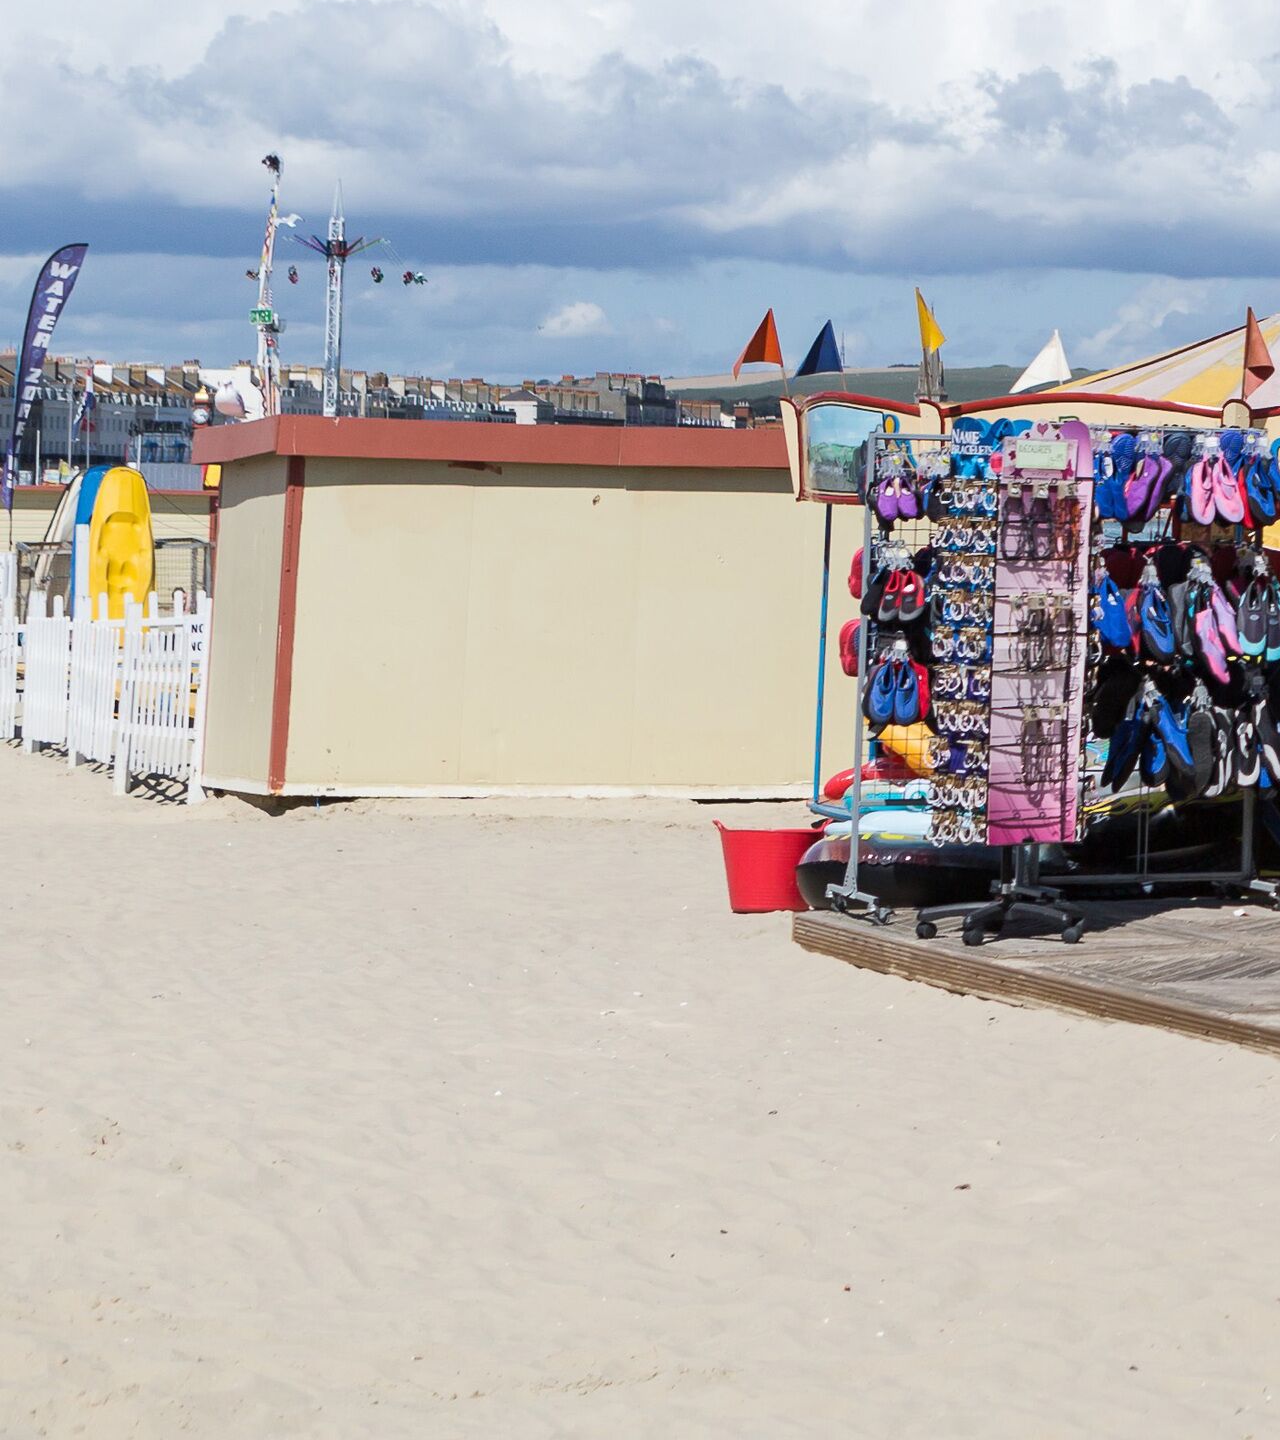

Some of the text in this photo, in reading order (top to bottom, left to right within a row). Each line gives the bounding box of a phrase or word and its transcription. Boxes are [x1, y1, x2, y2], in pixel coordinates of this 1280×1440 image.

[31, 260, 79, 350] WATER
[952, 428, 980, 445] NAME
[951, 444, 993, 456] BRACELETS
